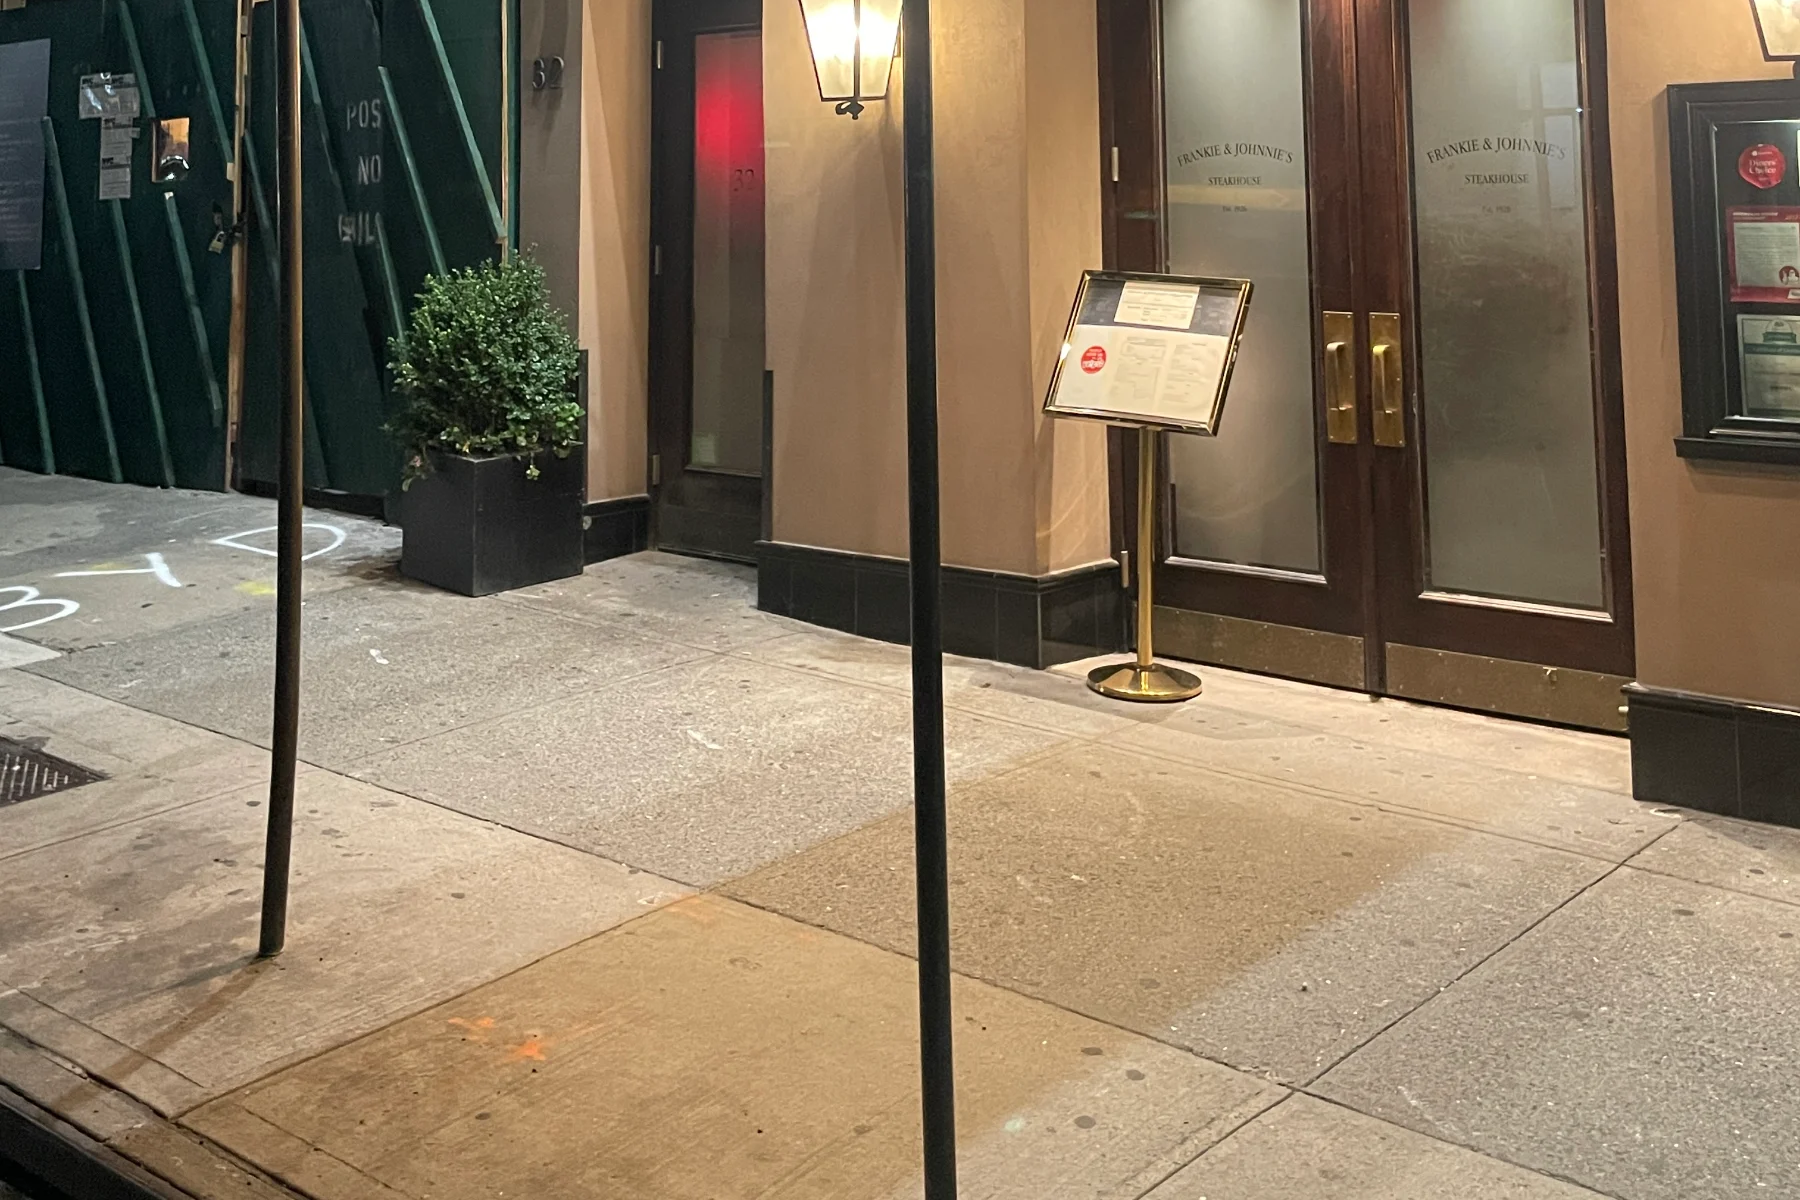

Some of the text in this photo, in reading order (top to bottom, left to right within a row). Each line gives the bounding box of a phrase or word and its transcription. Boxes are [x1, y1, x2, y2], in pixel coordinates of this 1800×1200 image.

[531, 56, 565, 90] 32
[1177, 143, 1294, 167] FRANKIE & JOHNNIE'S
[1427, 137, 1567, 164] FRANKIE & JOHNNIE'S
[358, 154, 382, 186] NO
[1208, 176, 1262, 186] STEAKHOUSE
[1464, 173, 1530, 185] STEAKHOUSE
